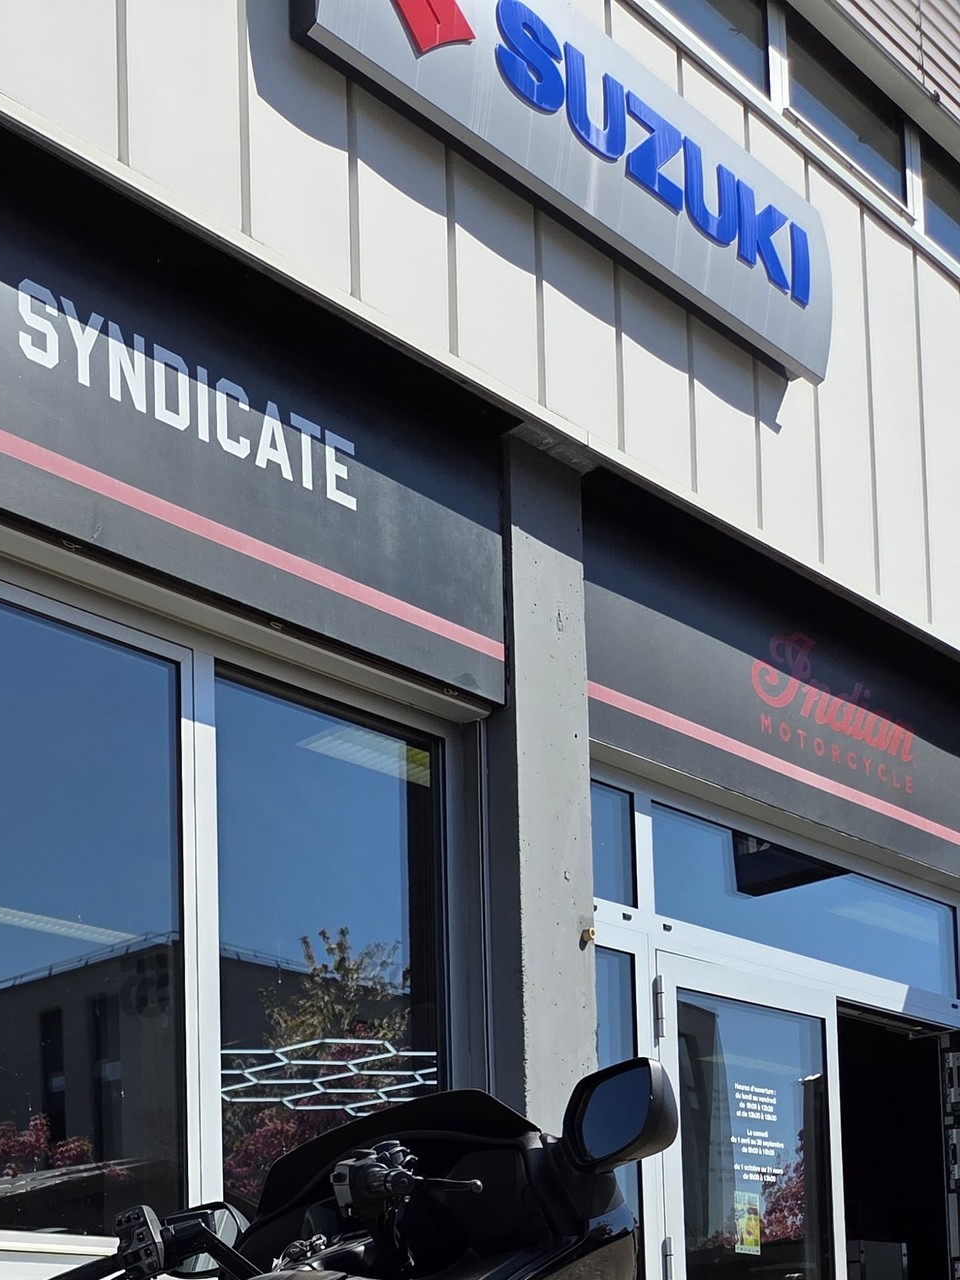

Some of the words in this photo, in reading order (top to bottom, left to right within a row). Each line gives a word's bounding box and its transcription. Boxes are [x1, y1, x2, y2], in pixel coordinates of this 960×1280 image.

[495, 0, 810, 307] SUZUKI
[17, 278, 358, 512] SYNDICATE
[751, 632, 914, 763] Indian
[759, 712, 913, 794] MOTORCYCLE
